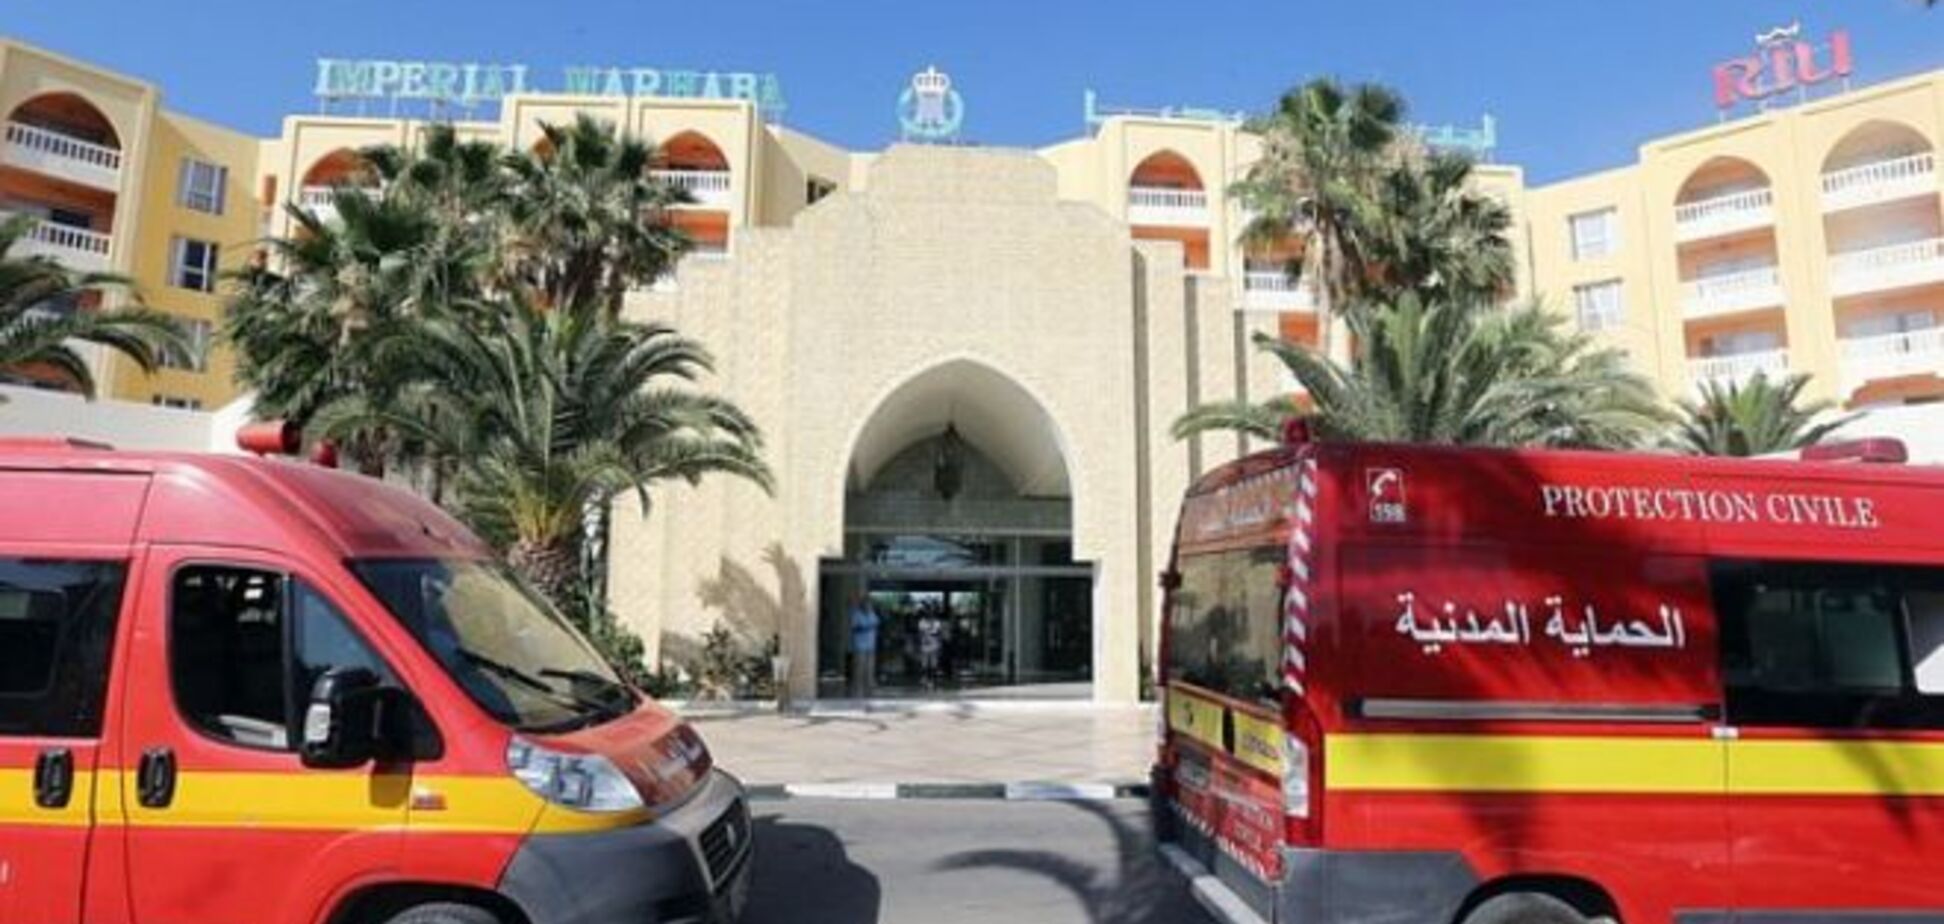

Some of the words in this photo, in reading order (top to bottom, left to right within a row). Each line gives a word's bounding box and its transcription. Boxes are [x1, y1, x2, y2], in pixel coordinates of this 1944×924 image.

[314, 57, 529, 106] IMPERIAL
[1541, 484, 1758, 524] PROTECTION
[1766, 493, 1879, 529] CIVILE
[1395, 590, 1530, 654] المدنية
[1545, 594, 1686, 656] الحماية
